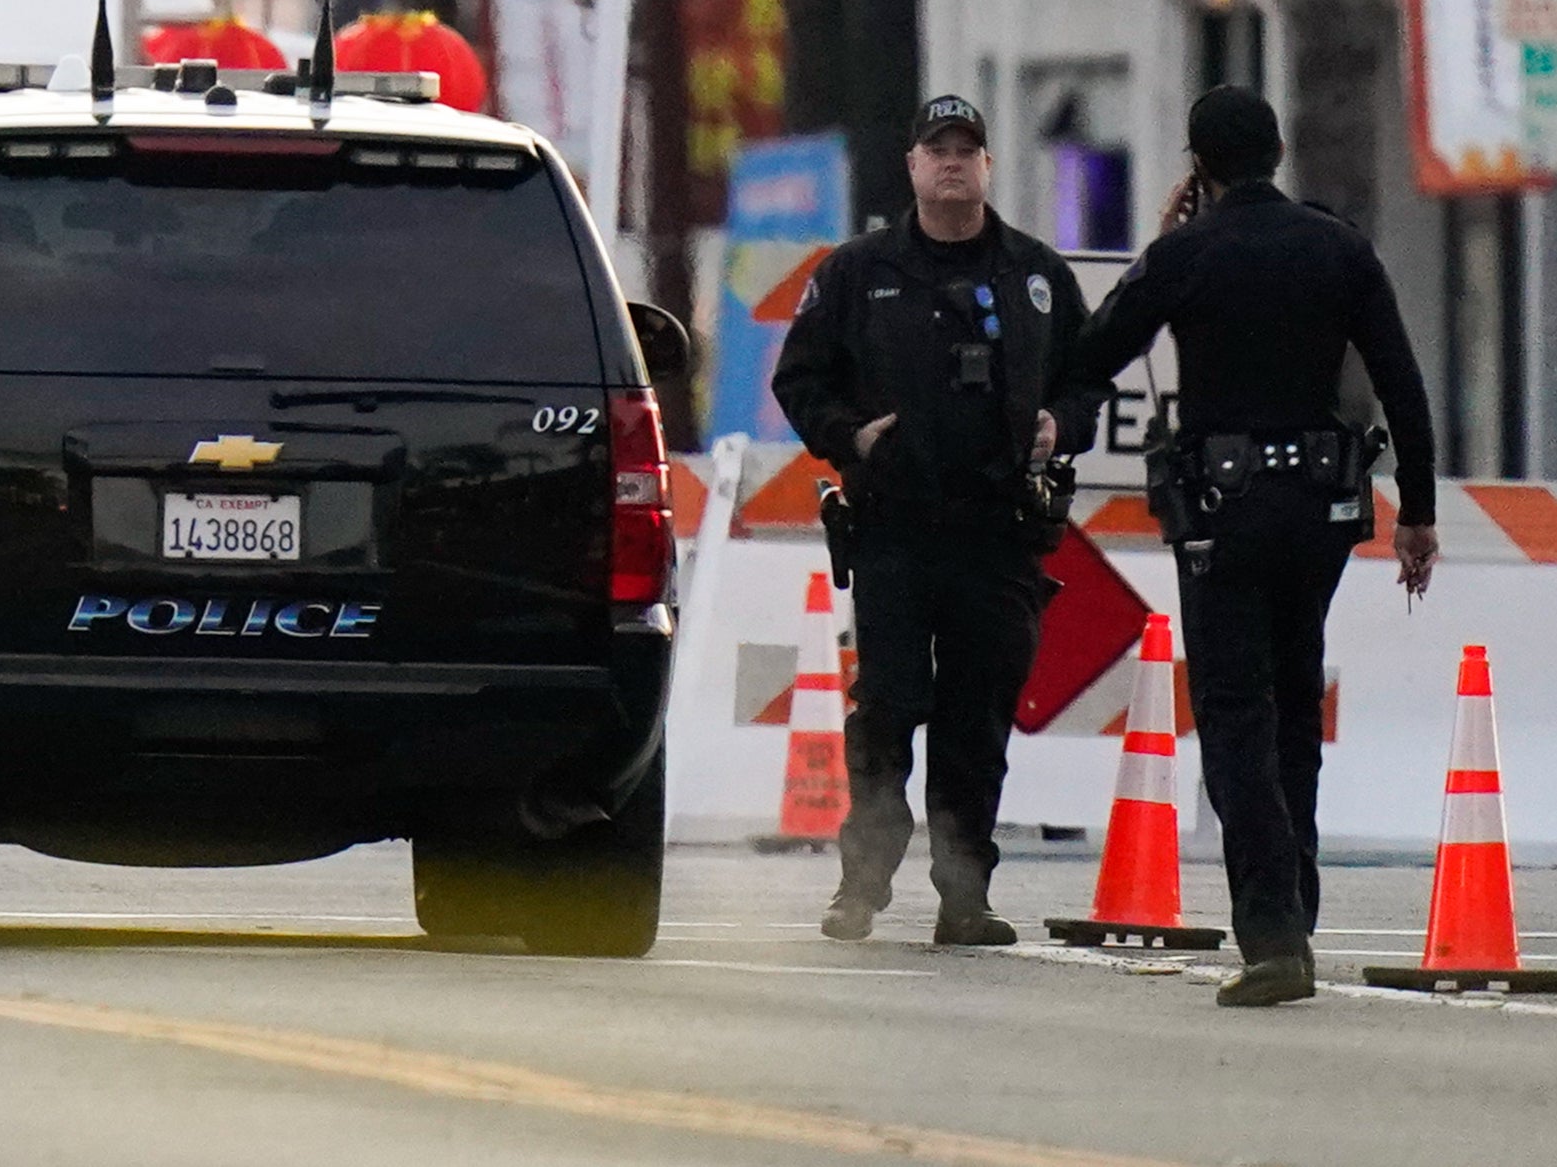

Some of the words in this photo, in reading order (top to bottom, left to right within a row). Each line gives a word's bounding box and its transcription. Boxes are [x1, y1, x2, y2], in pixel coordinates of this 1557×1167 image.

[532, 406, 599, 434] 092
[196, 499, 213, 509] CA
[220, 499, 270, 510] EXEMPT
[169, 518, 294, 552] 1438868
[66, 595, 382, 638] POLICE
